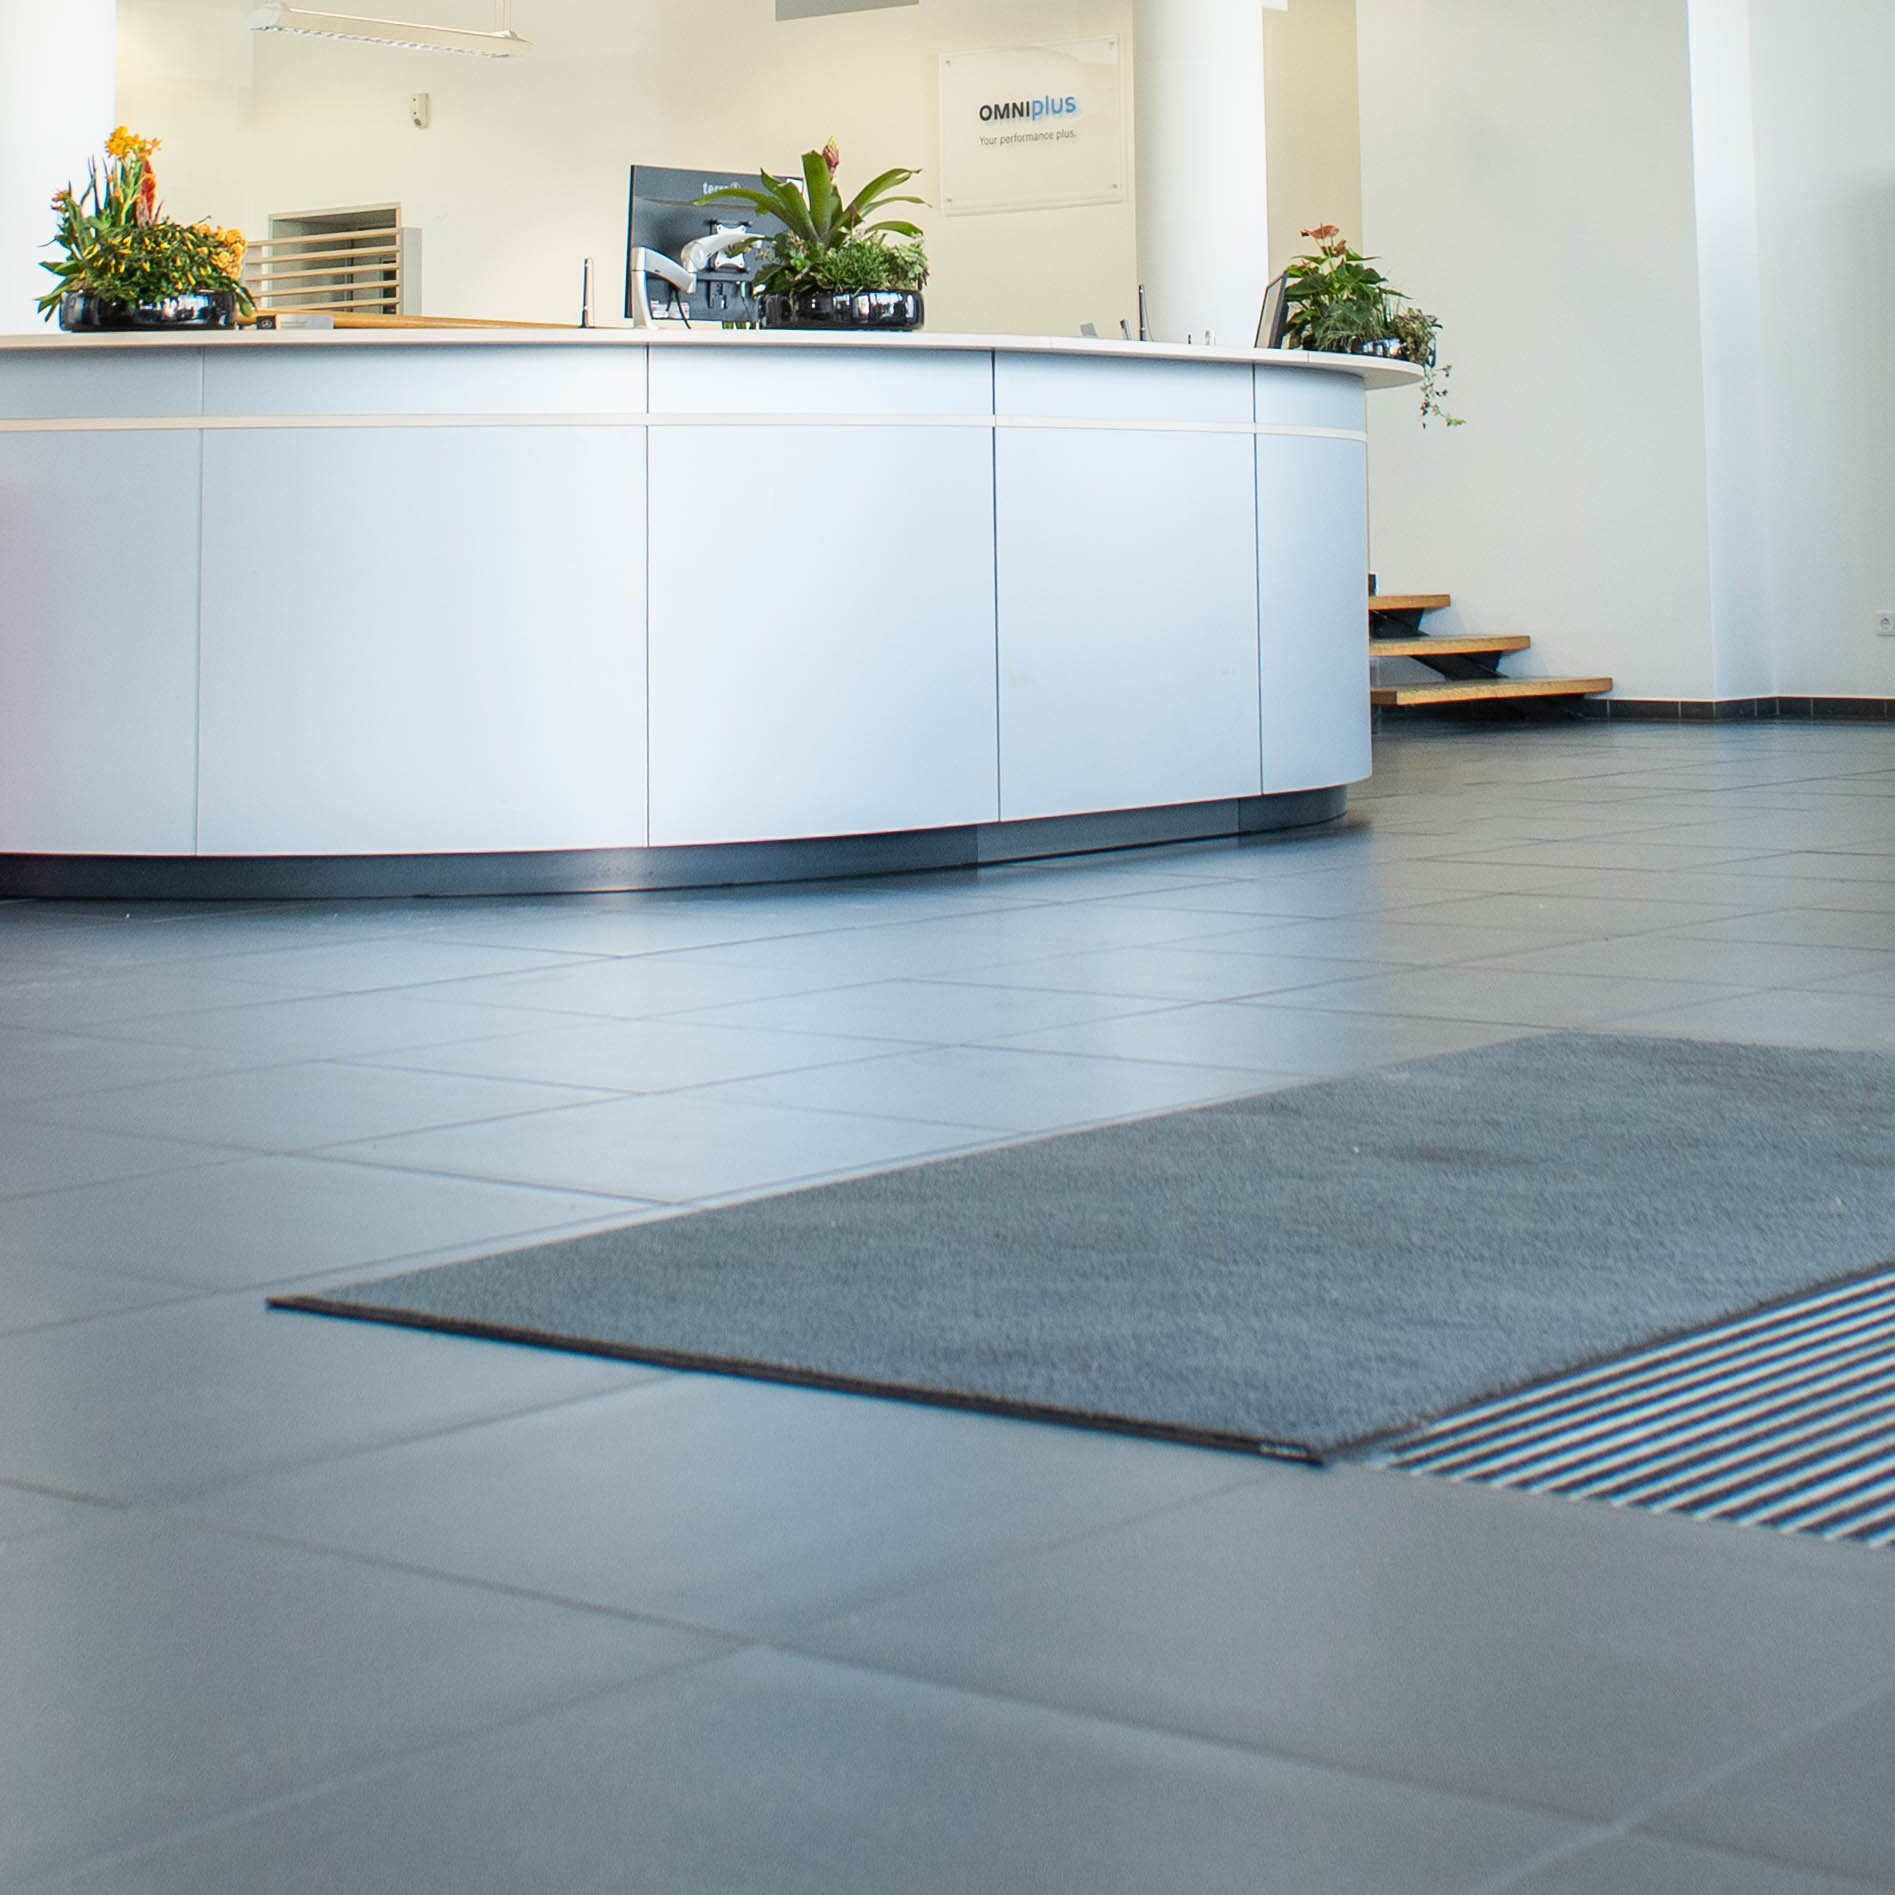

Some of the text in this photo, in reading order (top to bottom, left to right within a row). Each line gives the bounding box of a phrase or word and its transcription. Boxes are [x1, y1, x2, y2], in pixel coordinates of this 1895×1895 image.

[979, 95, 1077, 121] OMNIplus
[979, 128, 1077, 147] Your performance plus.
